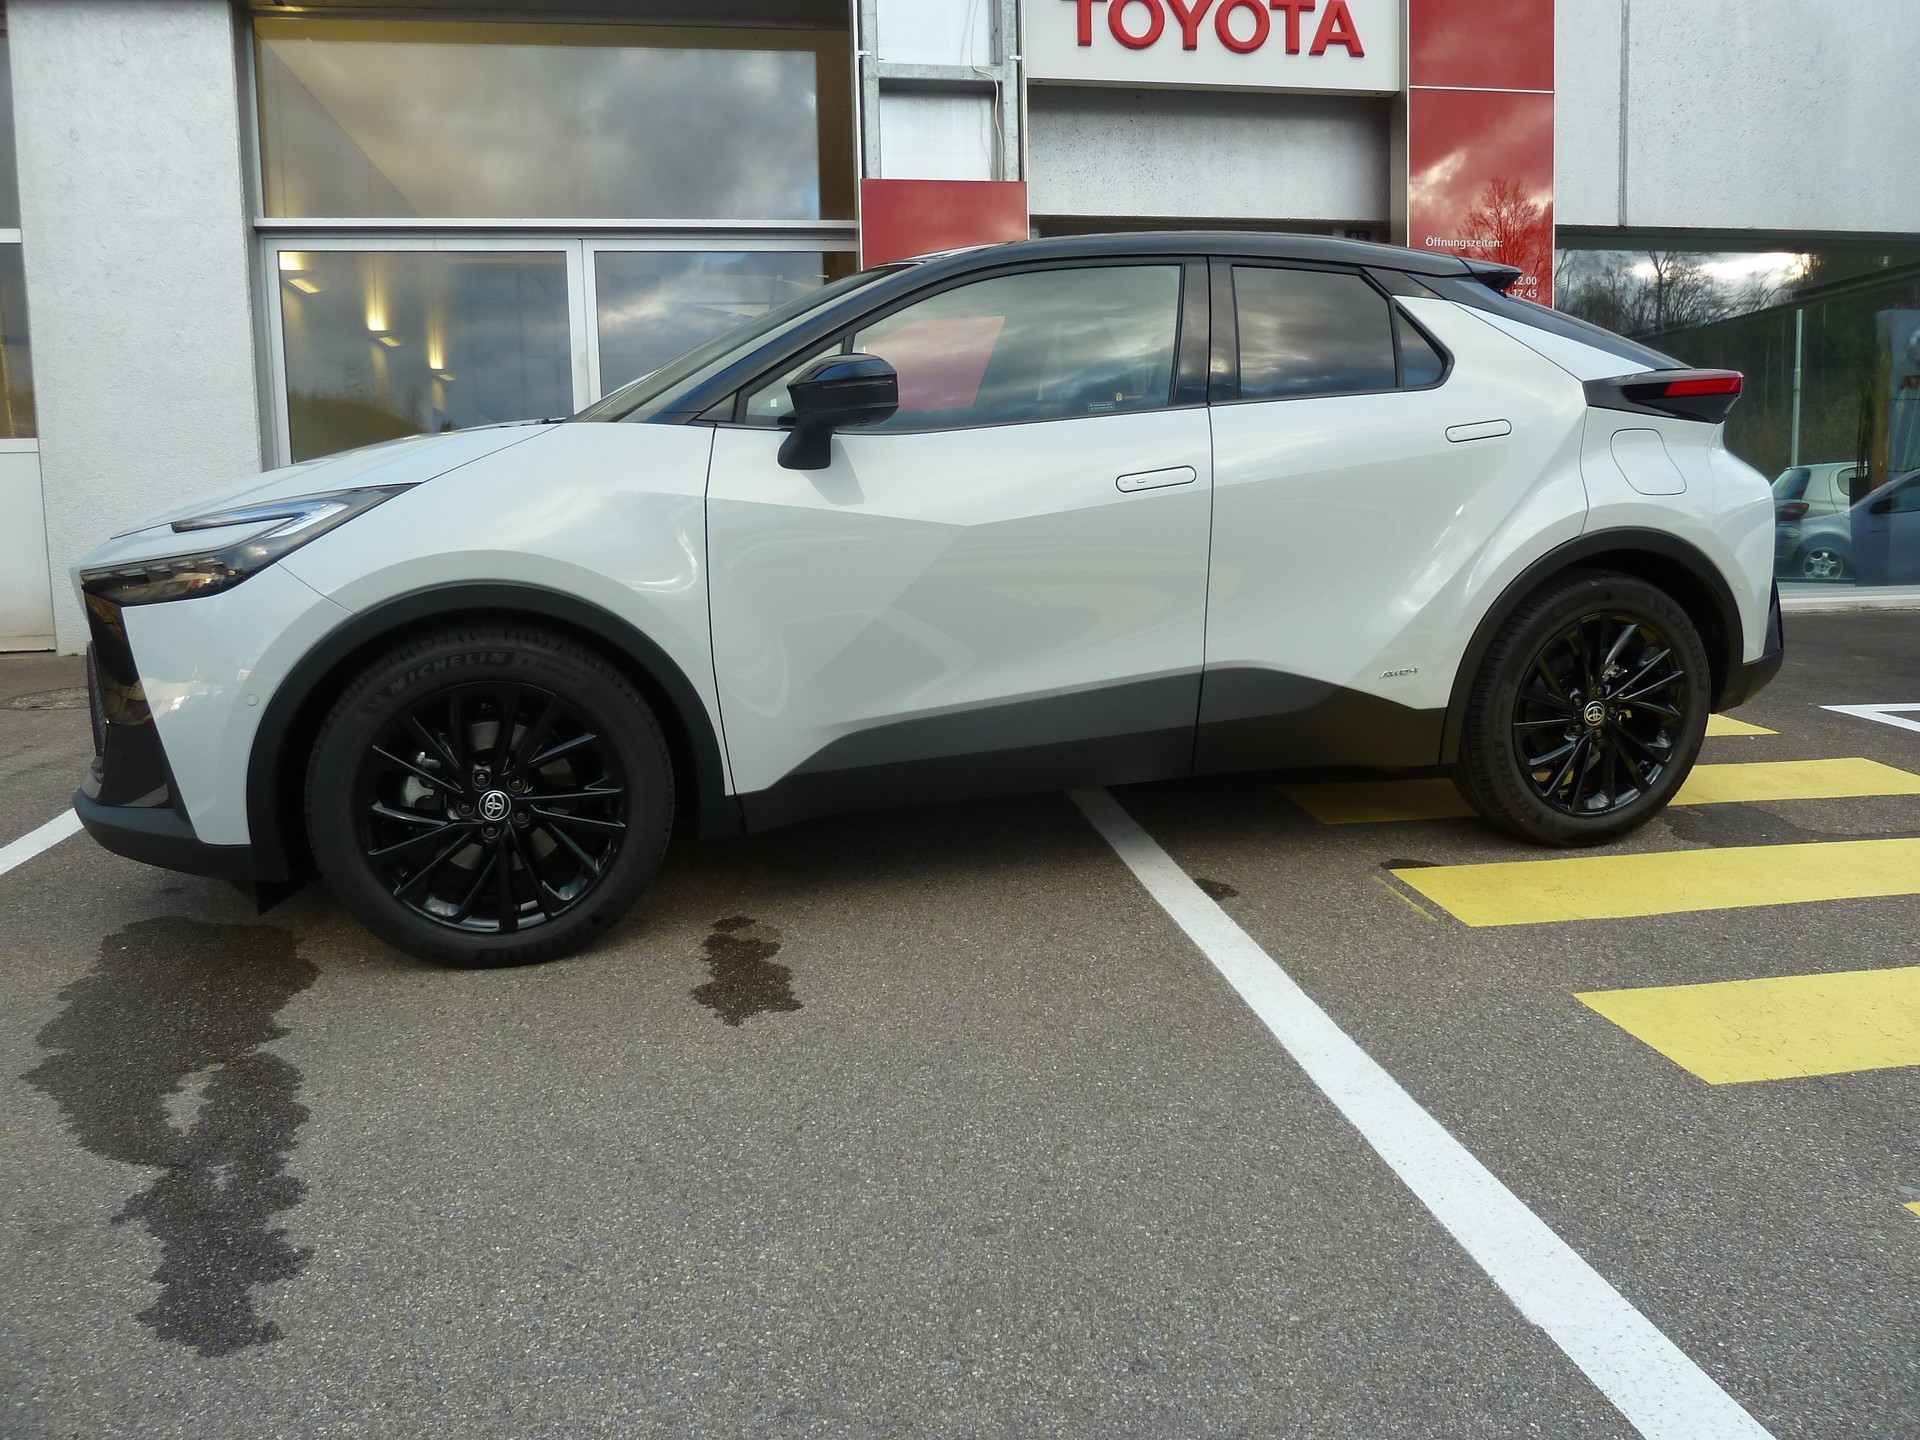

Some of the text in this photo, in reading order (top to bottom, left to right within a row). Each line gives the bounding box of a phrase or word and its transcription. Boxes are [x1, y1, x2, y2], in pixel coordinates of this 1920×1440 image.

[1060, 0, 1365, 58] TOYOTA
[1425, 235, 1503, 250] Öffnungszeiten:
[389, 652, 508, 693] MICHELIN
